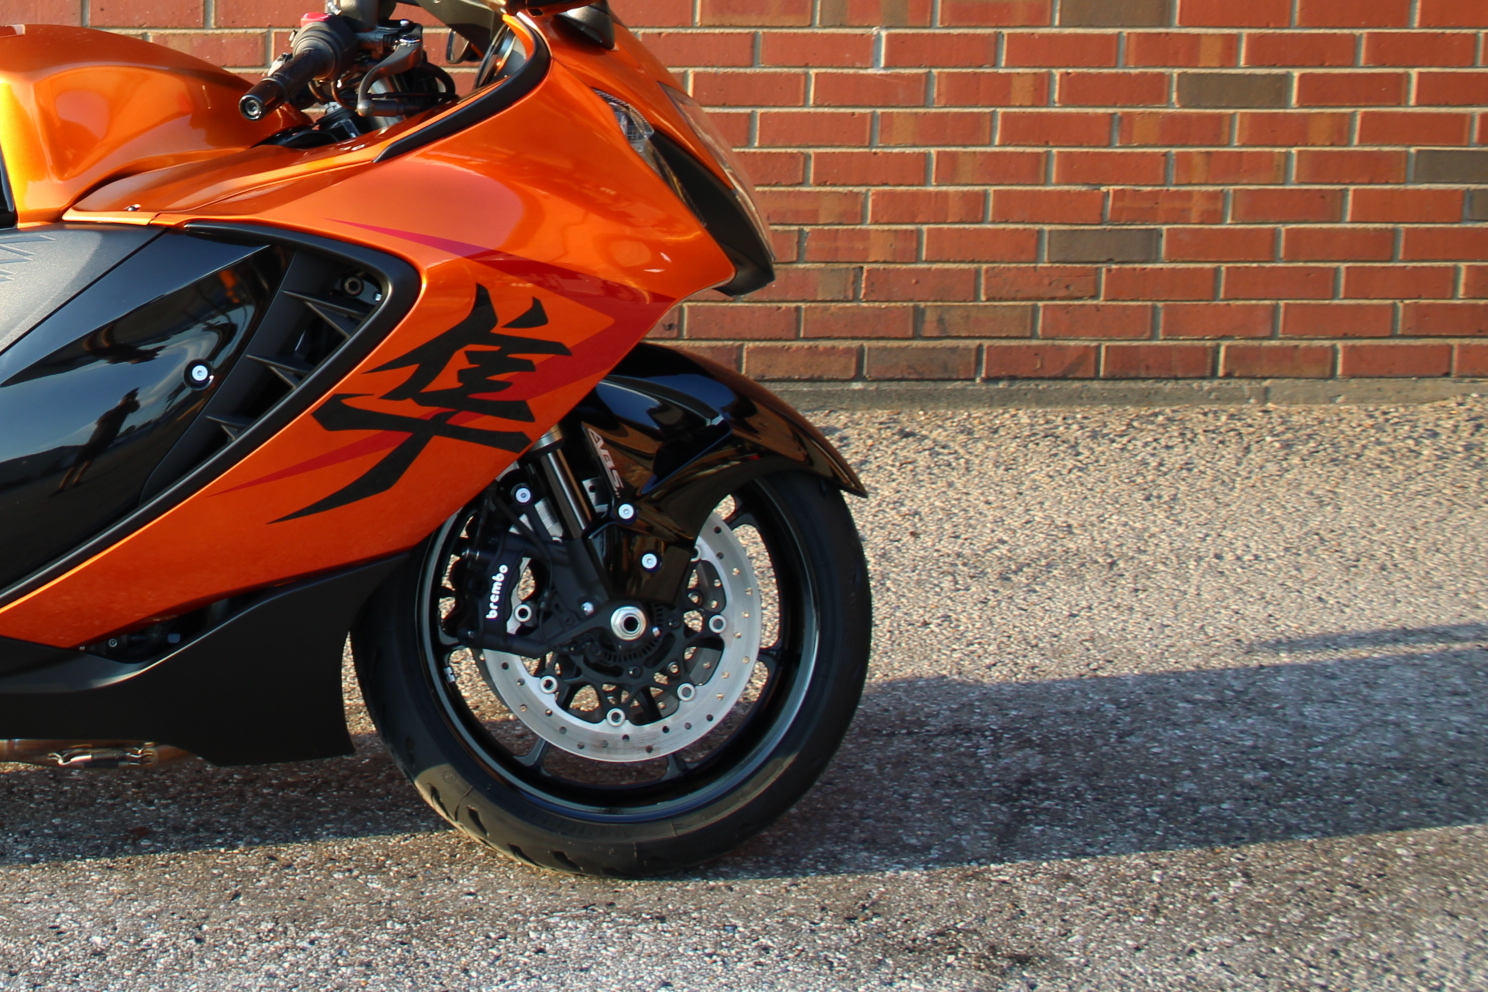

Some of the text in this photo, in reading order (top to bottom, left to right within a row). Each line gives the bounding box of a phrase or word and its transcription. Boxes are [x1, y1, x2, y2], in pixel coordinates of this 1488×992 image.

[266, 282, 573, 524] 隼
[587, 428, 624, 492] ABS
[485, 564, 509, 619] brembo
